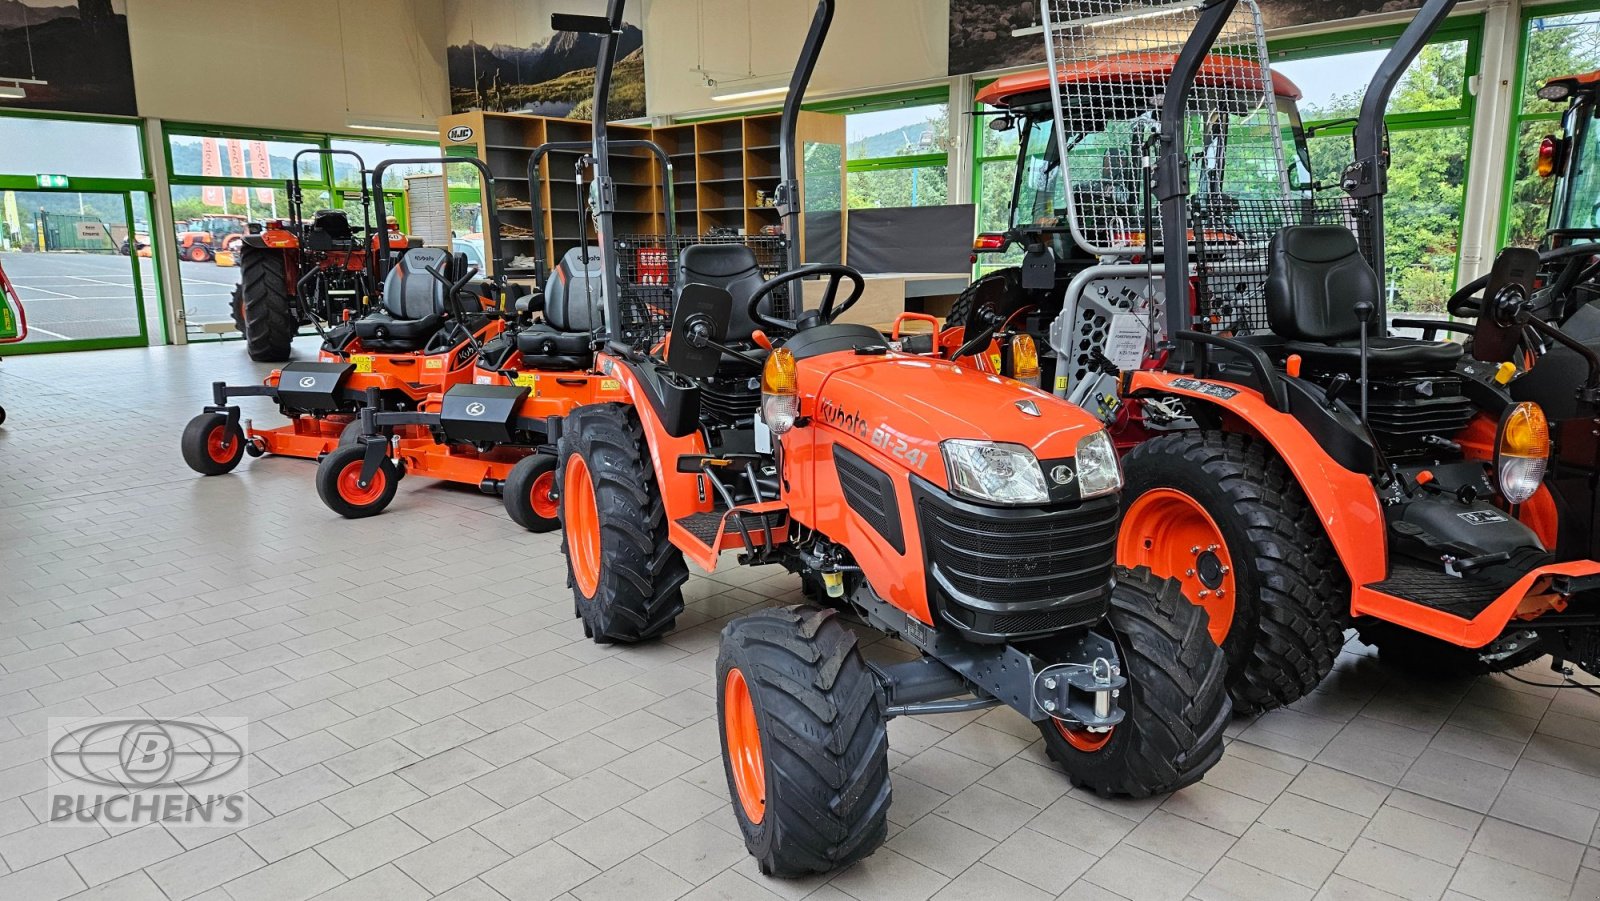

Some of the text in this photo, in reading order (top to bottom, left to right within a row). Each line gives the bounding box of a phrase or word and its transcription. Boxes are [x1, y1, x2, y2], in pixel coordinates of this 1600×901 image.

[450, 129, 469, 138] HJC
[820, 398, 929, 470] Kubota B1-241
